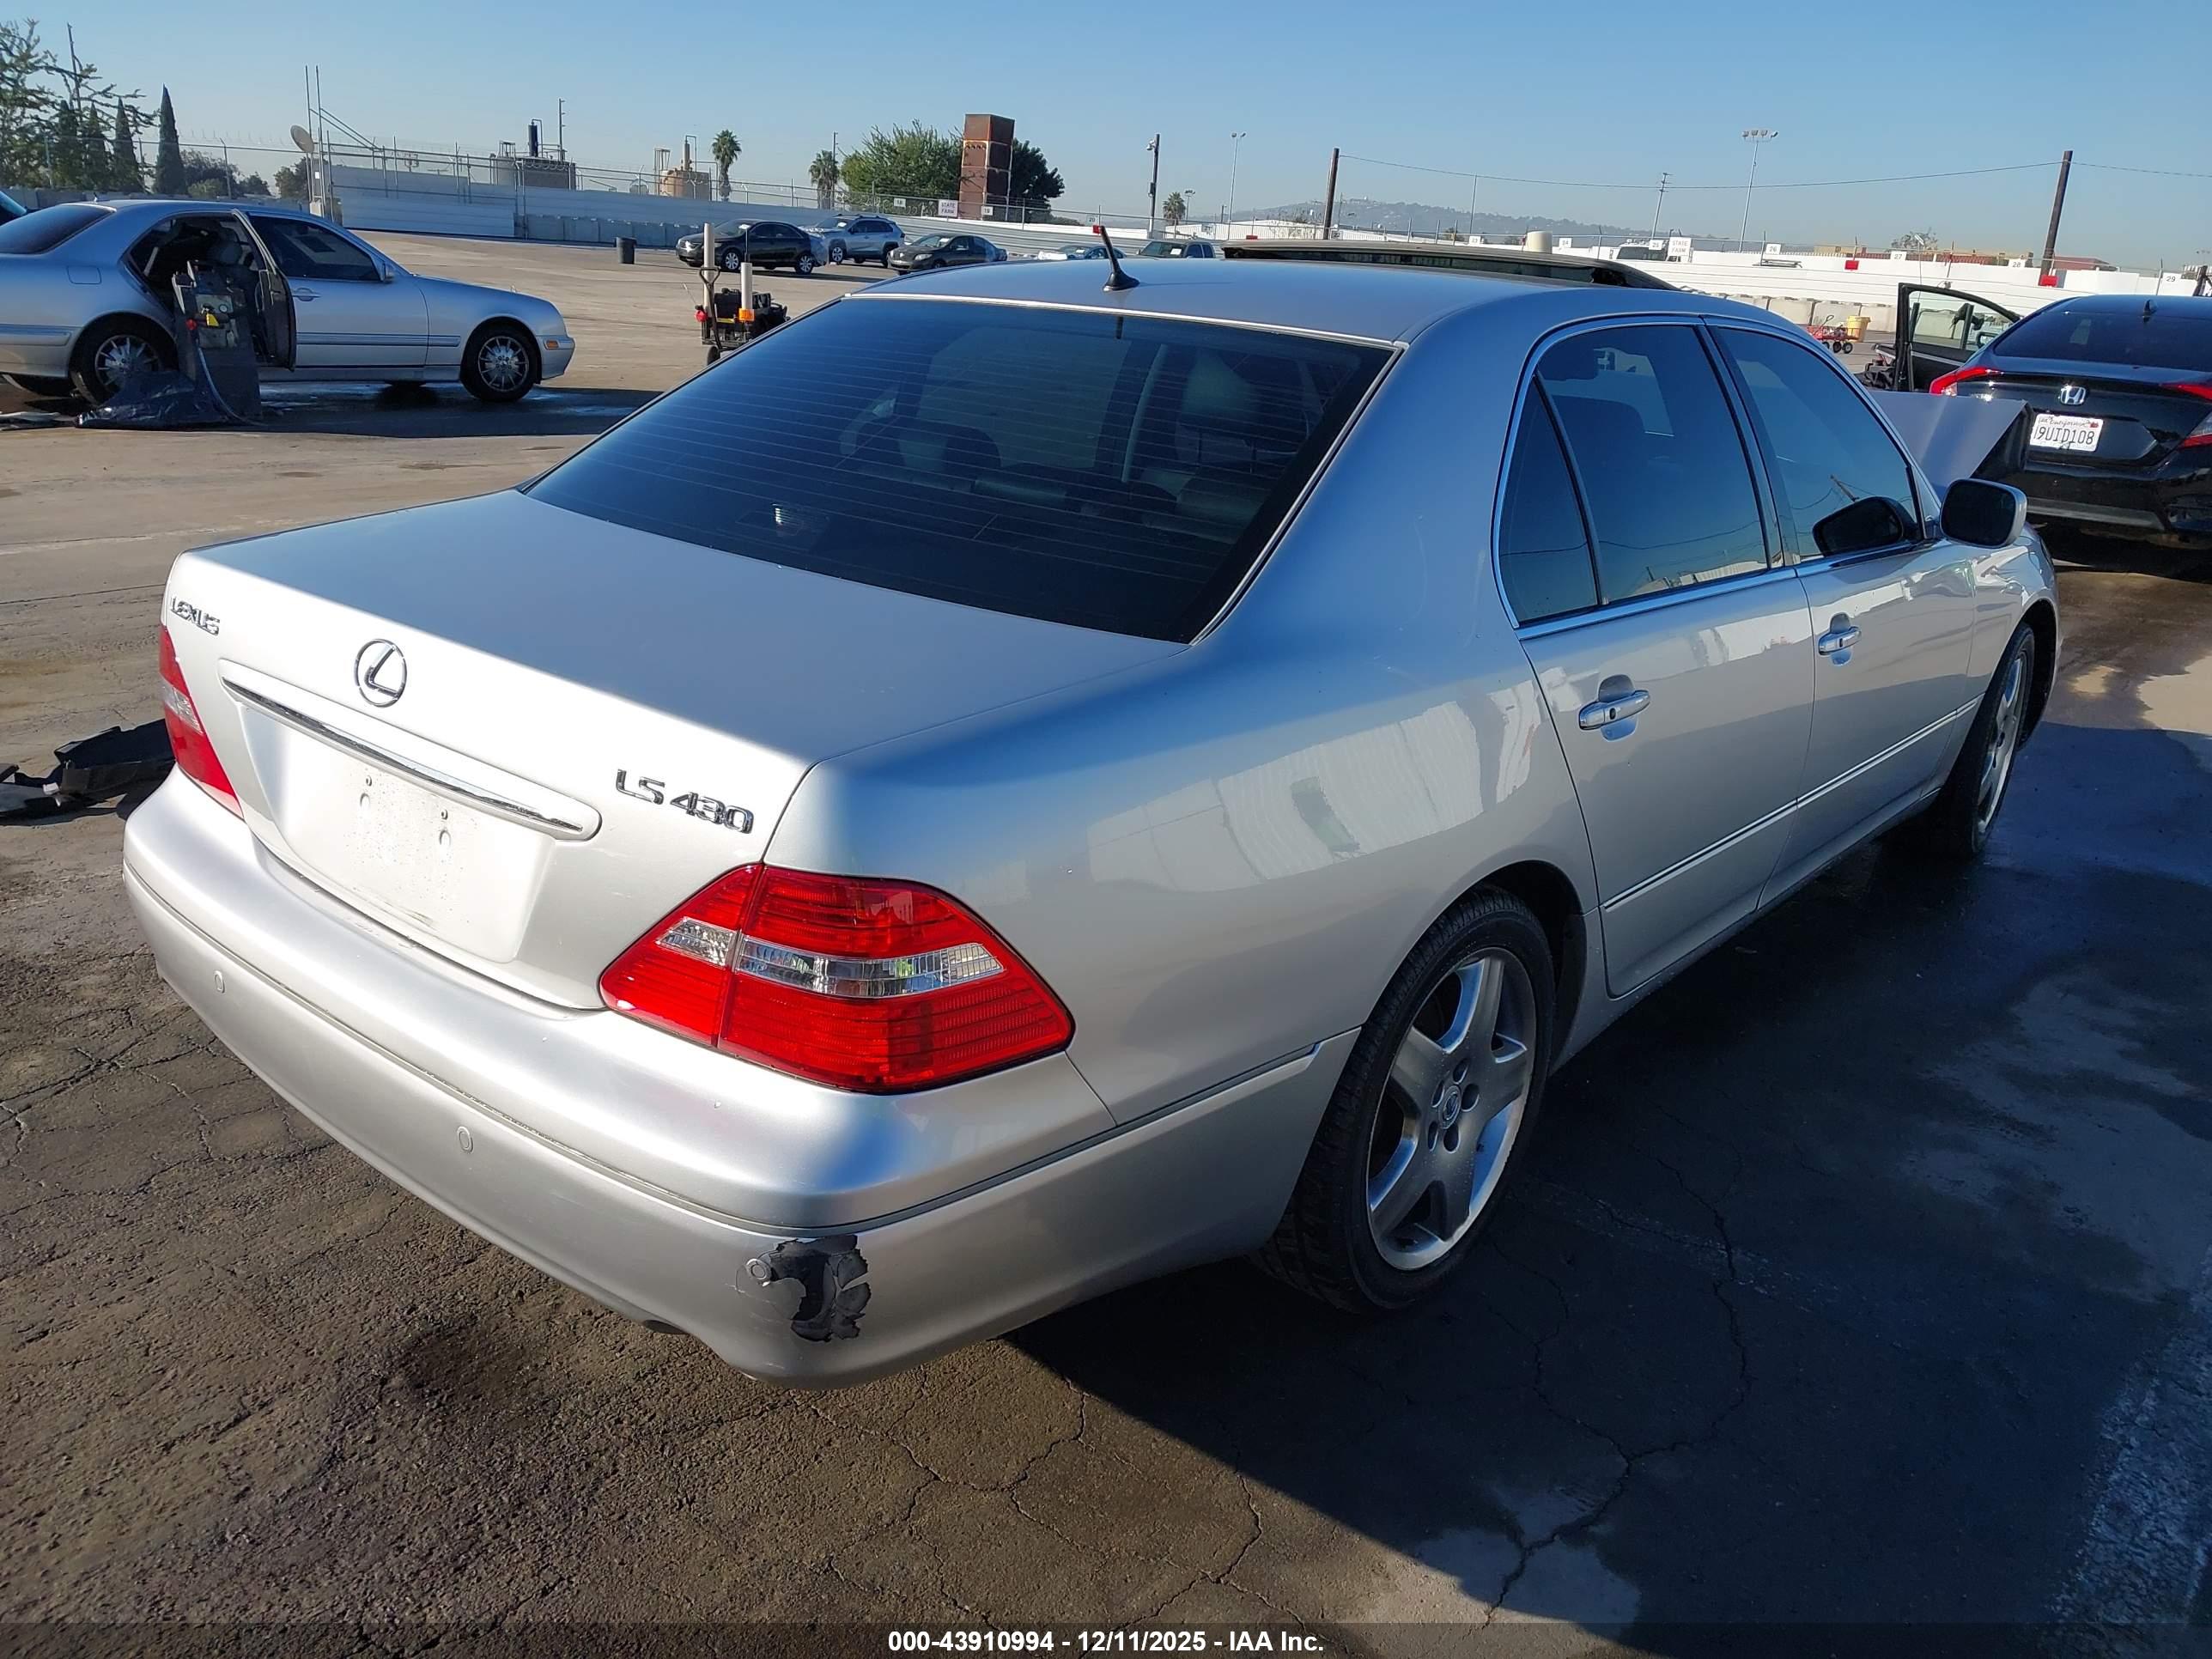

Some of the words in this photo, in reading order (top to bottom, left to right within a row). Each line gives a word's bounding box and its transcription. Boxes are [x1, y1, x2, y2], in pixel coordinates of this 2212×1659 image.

[2037, 426, 2095, 445] 9UID108
[170, 596, 221, 636] LEXUS
[616, 769, 665, 805] LS
[670, 791, 755, 835] 430
